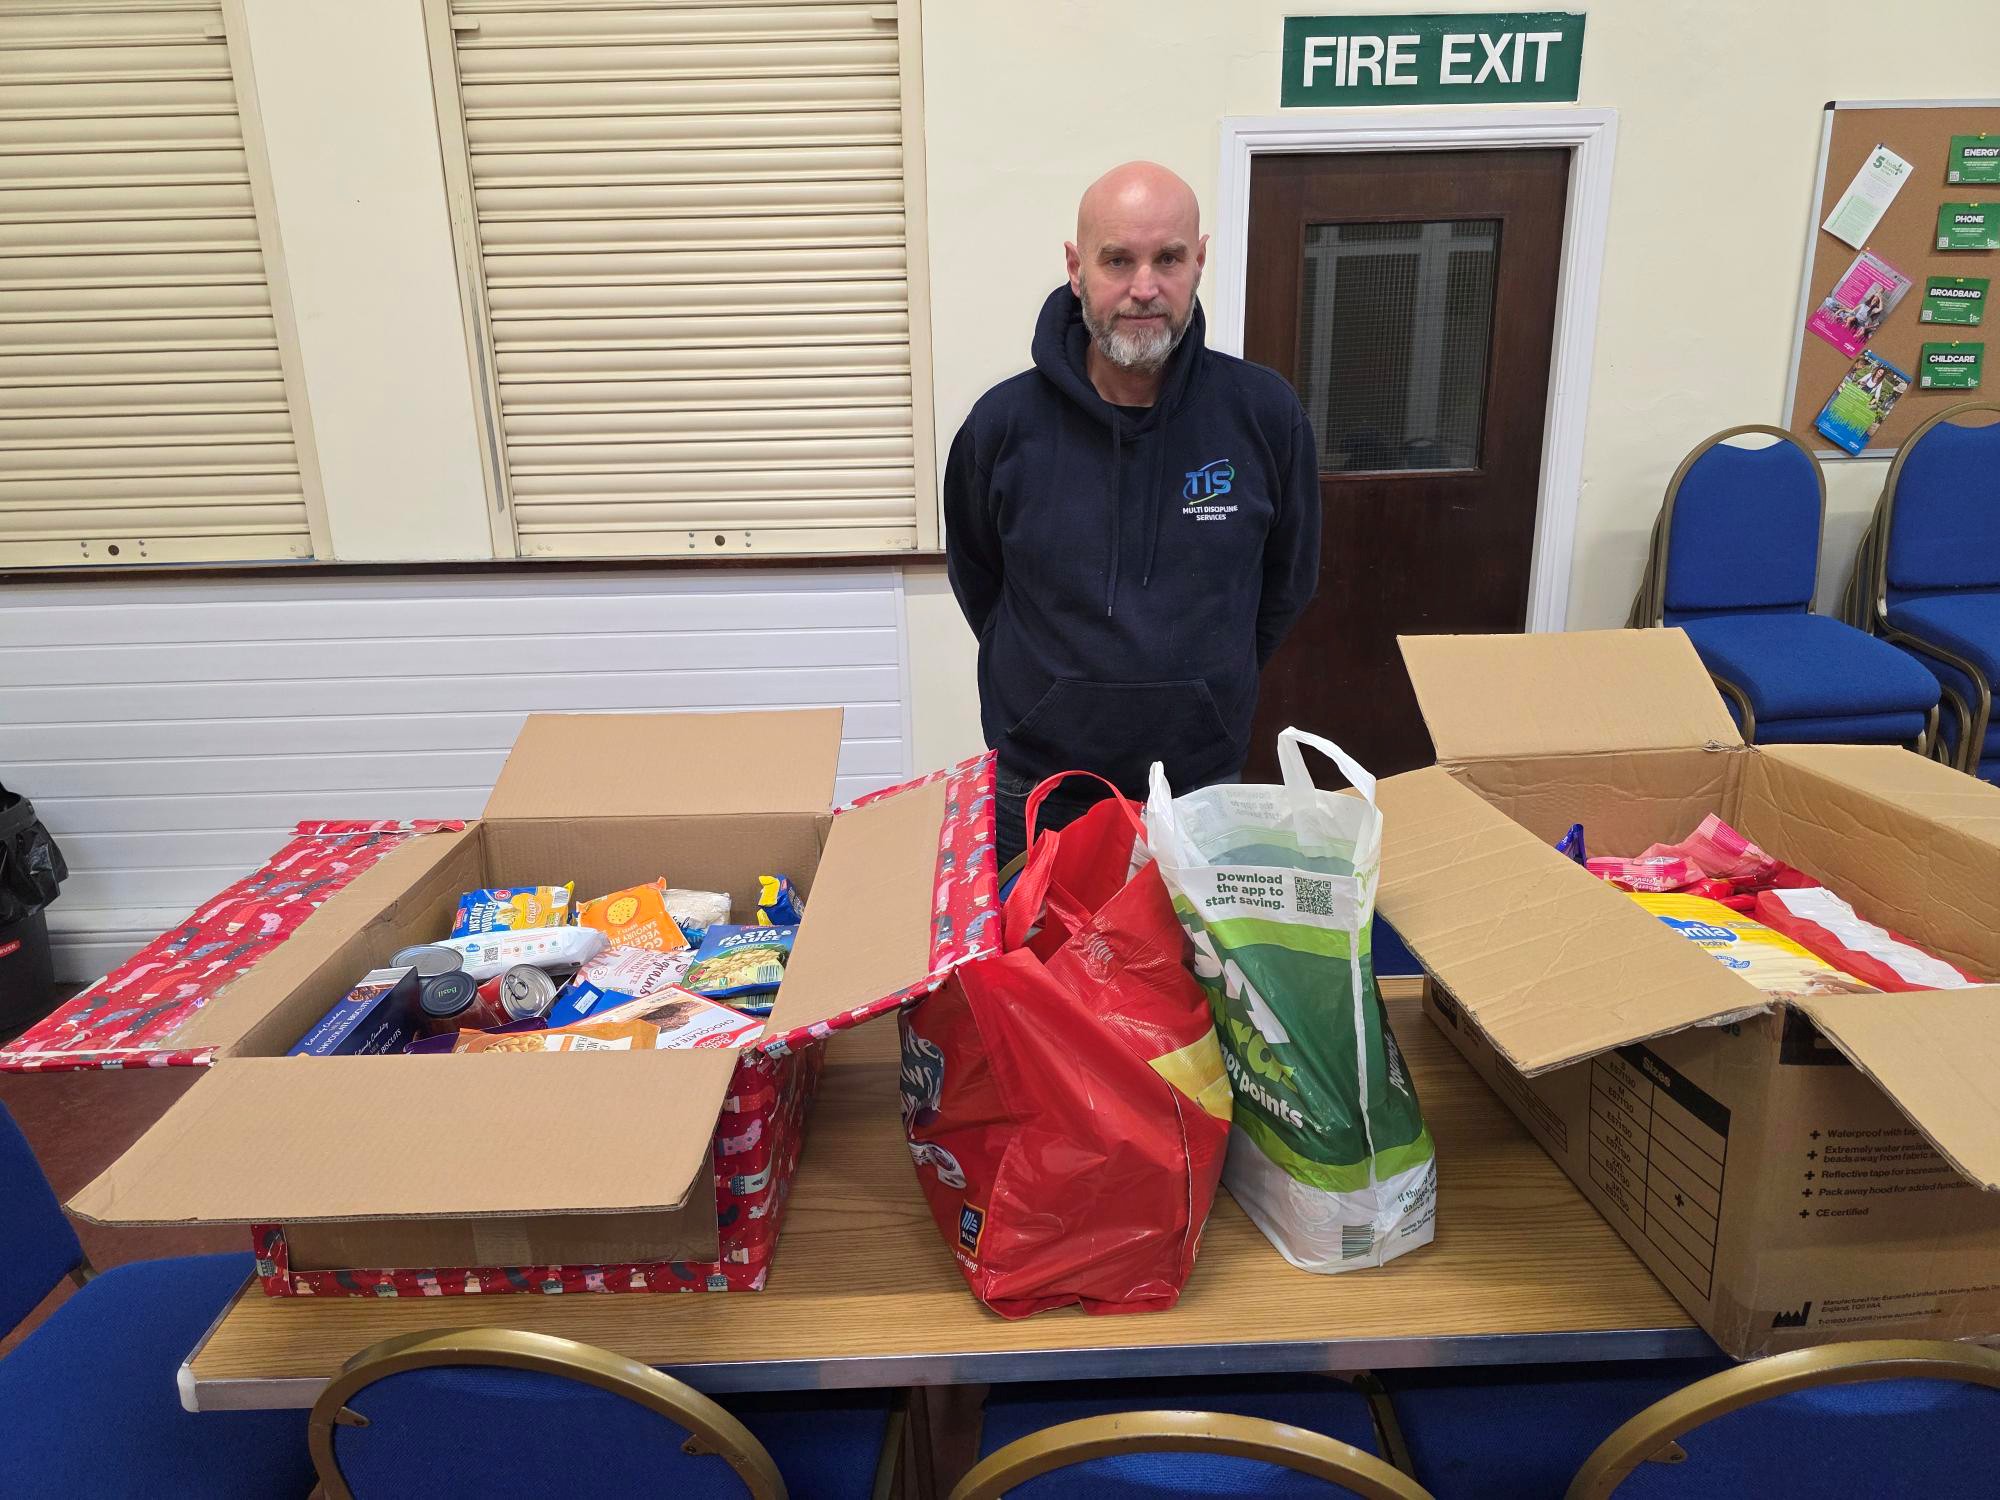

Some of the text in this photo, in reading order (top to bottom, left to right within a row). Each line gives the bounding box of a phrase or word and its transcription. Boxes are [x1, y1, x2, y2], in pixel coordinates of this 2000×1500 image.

[1303, 31, 1563, 87] FIRE EXIT
[1963, 148, 1999, 157] ENERGY
[1955, 215, 1984, 223] PHONE
[1930, 288, 1981, 299] BROADBAND
[1929, 354, 1976, 364] CHILDCARE
[1185, 470, 1232, 495] TIS
[1182, 504, 1239, 515] MULTI DISCIPLINE
[1196, 513, 1227, 521] SERVICES
[1216, 872, 1283, 885] Download
[1216, 883, 1284, 897] the app to
[1205, 894, 1285, 910] start saving.
[469, 902, 486, 932] INSTANT
[718, 929, 779, 947] PASTA
[723, 935, 781, 948] SAUCE
[437, 986, 458, 998] Basil
[682, 1018, 735, 1043] CHOCOLATE
[1642, 1056, 1671, 1088] Sizes
[1618, 1086, 1625, 1097] M
[1239, 1073, 1304, 1129] points
[1827, 1129, 1882, 1139] Waterproof
[1882, 1129, 1903, 1137] with
[1824, 1145, 1873, 1155] Extremely
[1873, 1144, 1900, 1153] water
[1823, 1155, 1853, 1163] beads
[1853, 1155, 1878, 1164] away
[1879, 1153, 1902, 1162] from
[1902, 1152, 1928, 1161] fabric
[1821, 1165, 1950, 1179] Reflective tape for increased
[1819, 1188, 1844, 1197] Pack
[1844, 1188, 1869, 1198] away
[1869, 1185, 1894, 1195] hood
[1893, 1185, 1907, 1194] for
[1907, 1183, 1937, 1193] added
[1815, 1207, 1870, 1218] CE certified
